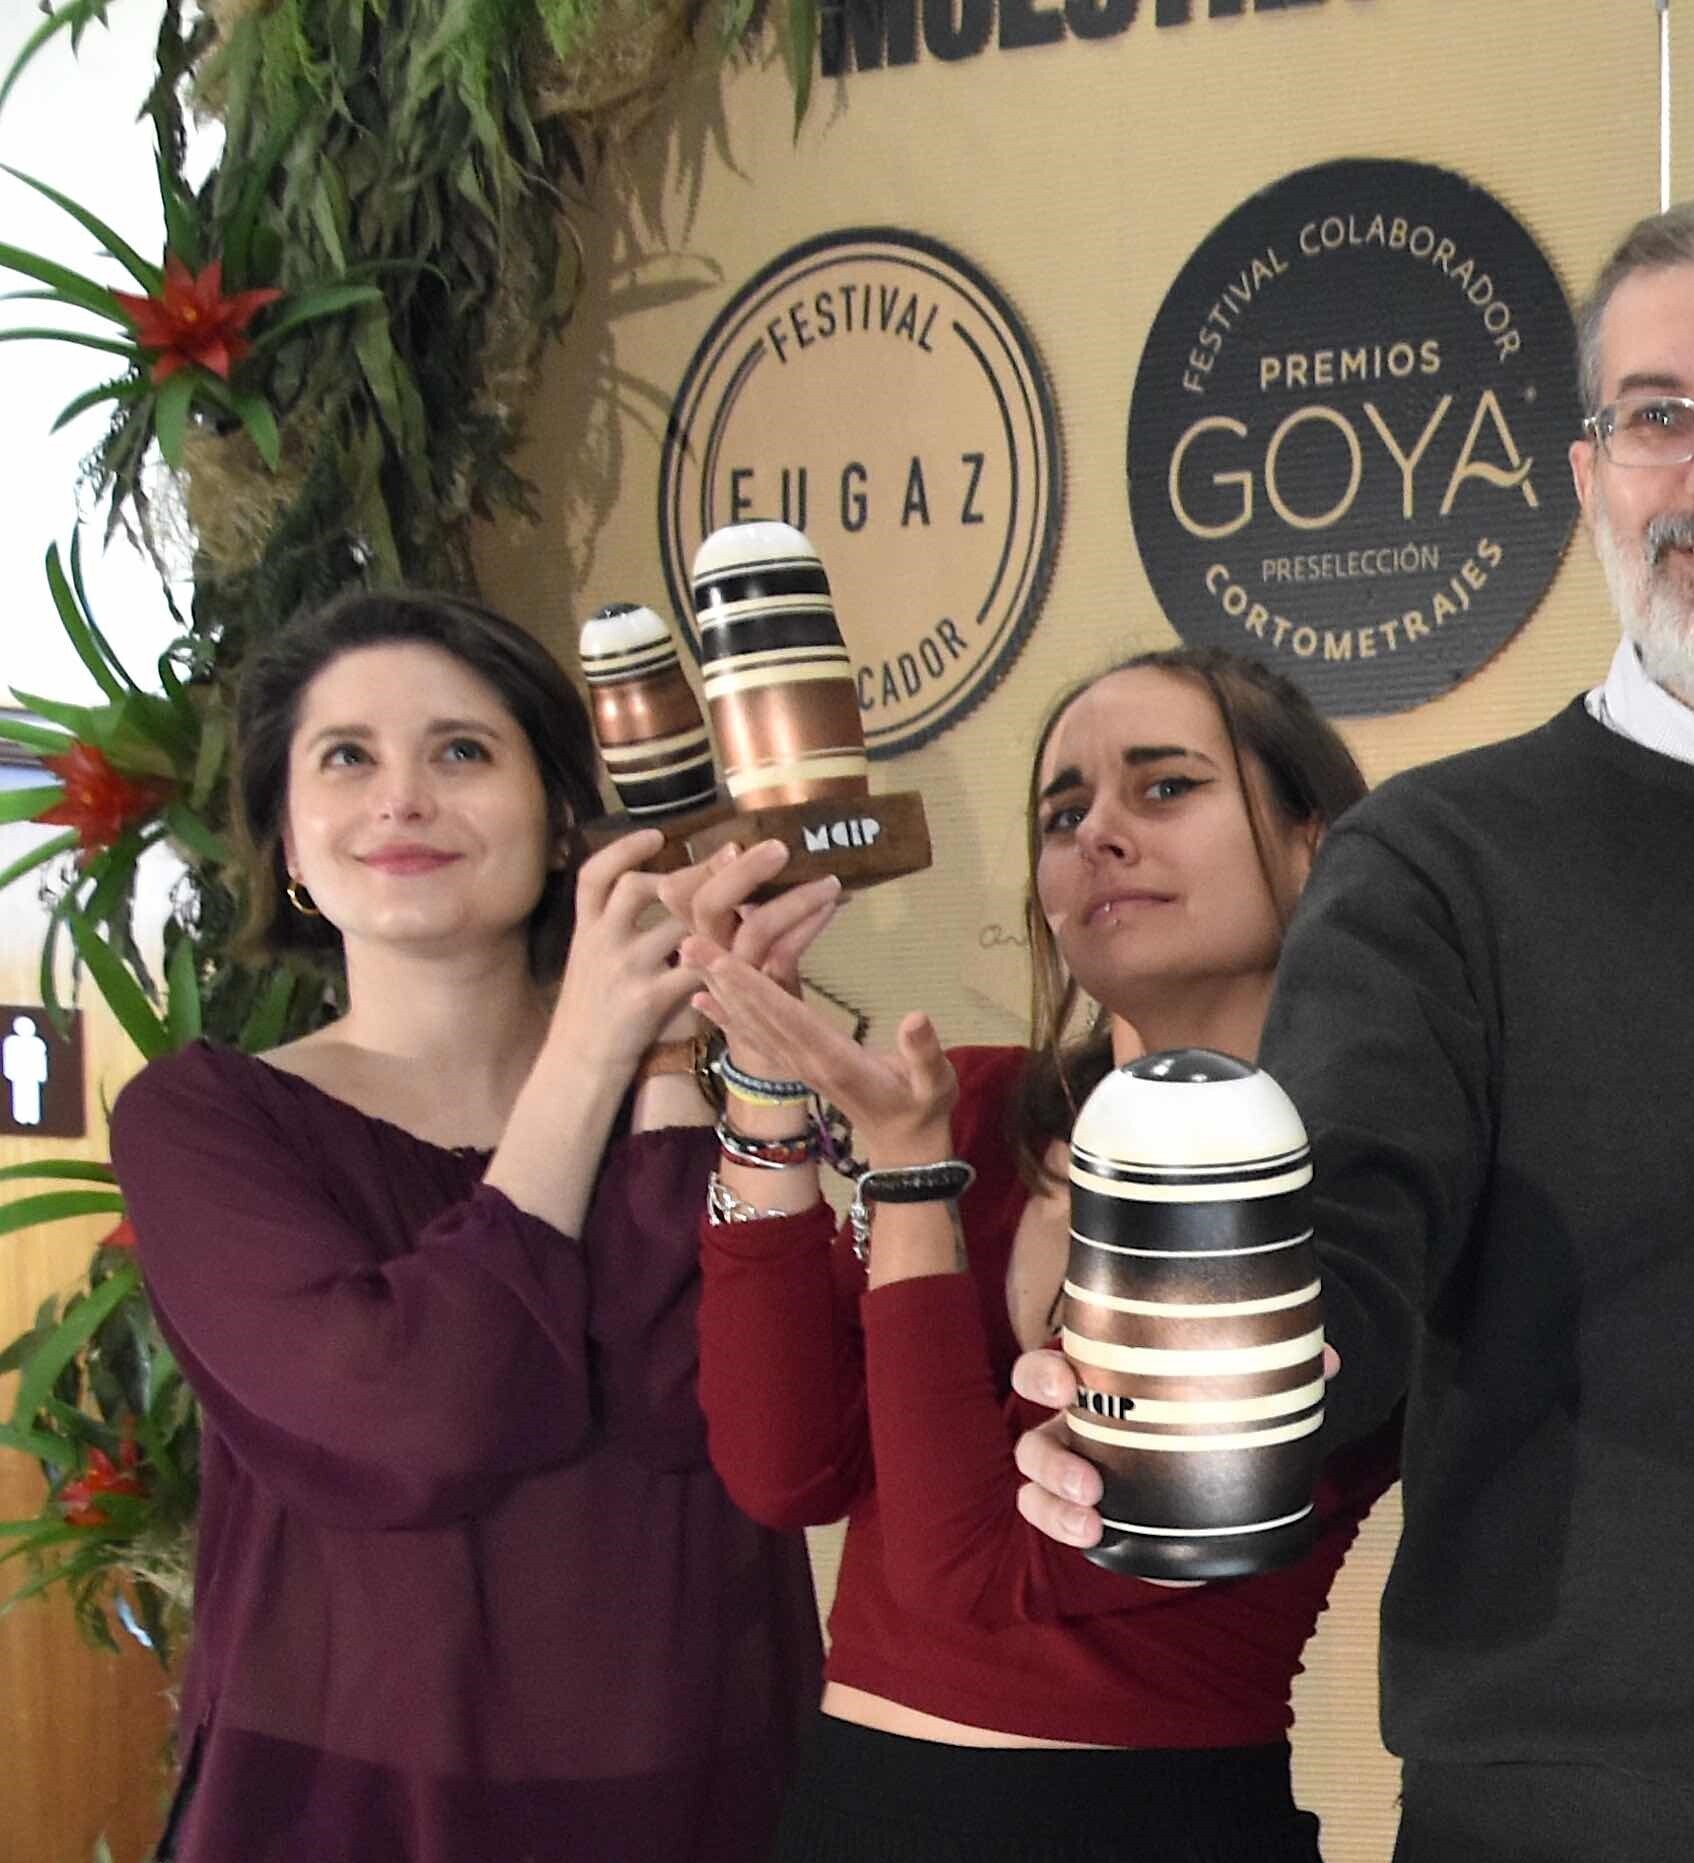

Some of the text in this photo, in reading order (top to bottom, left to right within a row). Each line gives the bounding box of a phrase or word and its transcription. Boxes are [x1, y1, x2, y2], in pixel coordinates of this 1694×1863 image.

[767, 284, 939, 364] FESTIVAL
[1183, 214, 1521, 392] FESTIVAL COLABORADOR
[1260, 340, 1441, 391] PREMIOS
[1169, 390, 1539, 539] GOYA
[1206, 537, 1502, 661] CORTOMETRAJES
[1262, 543, 1439, 583] PRESELECCIÓN
